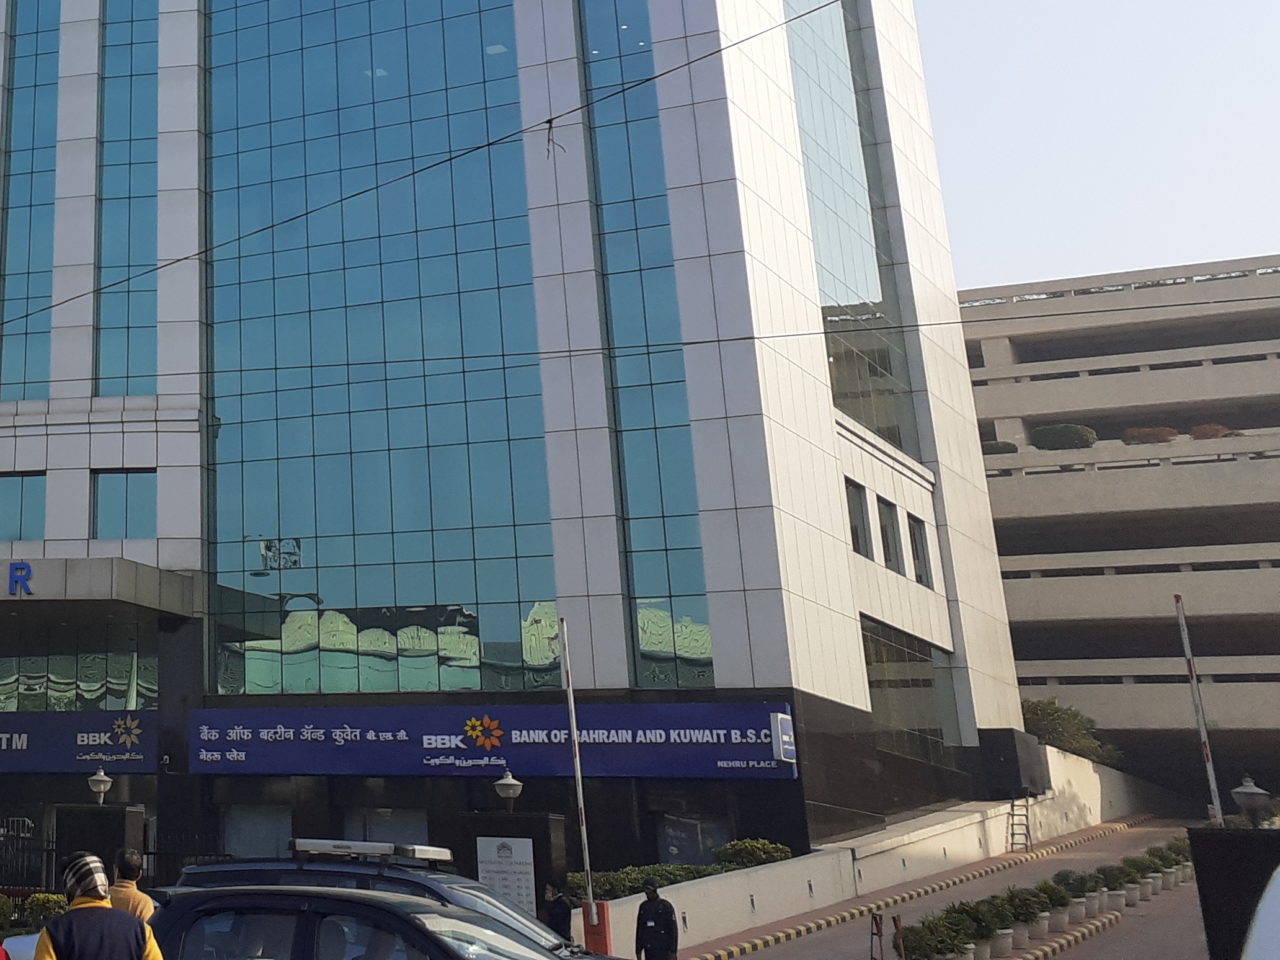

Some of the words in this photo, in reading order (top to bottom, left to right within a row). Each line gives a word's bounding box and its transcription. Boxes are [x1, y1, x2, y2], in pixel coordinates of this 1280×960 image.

[76, 733, 114, 745] BBK
[199, 725, 220, 741] बैंक
[226, 725, 252, 741] ऑफ
[259, 725, 295, 741] बहरीन
[331, 725, 362, 745] कुवेत
[511, 730, 548, 744] BANK
[550, 730, 569, 743] OF
[635, 729, 666, 743] AND
[670, 729, 727, 743] KUWAIT
[423, 735, 468, 749] BBK
[226, 748, 246, 761] प्लेस
[717, 761, 747, 769] NEHRU
